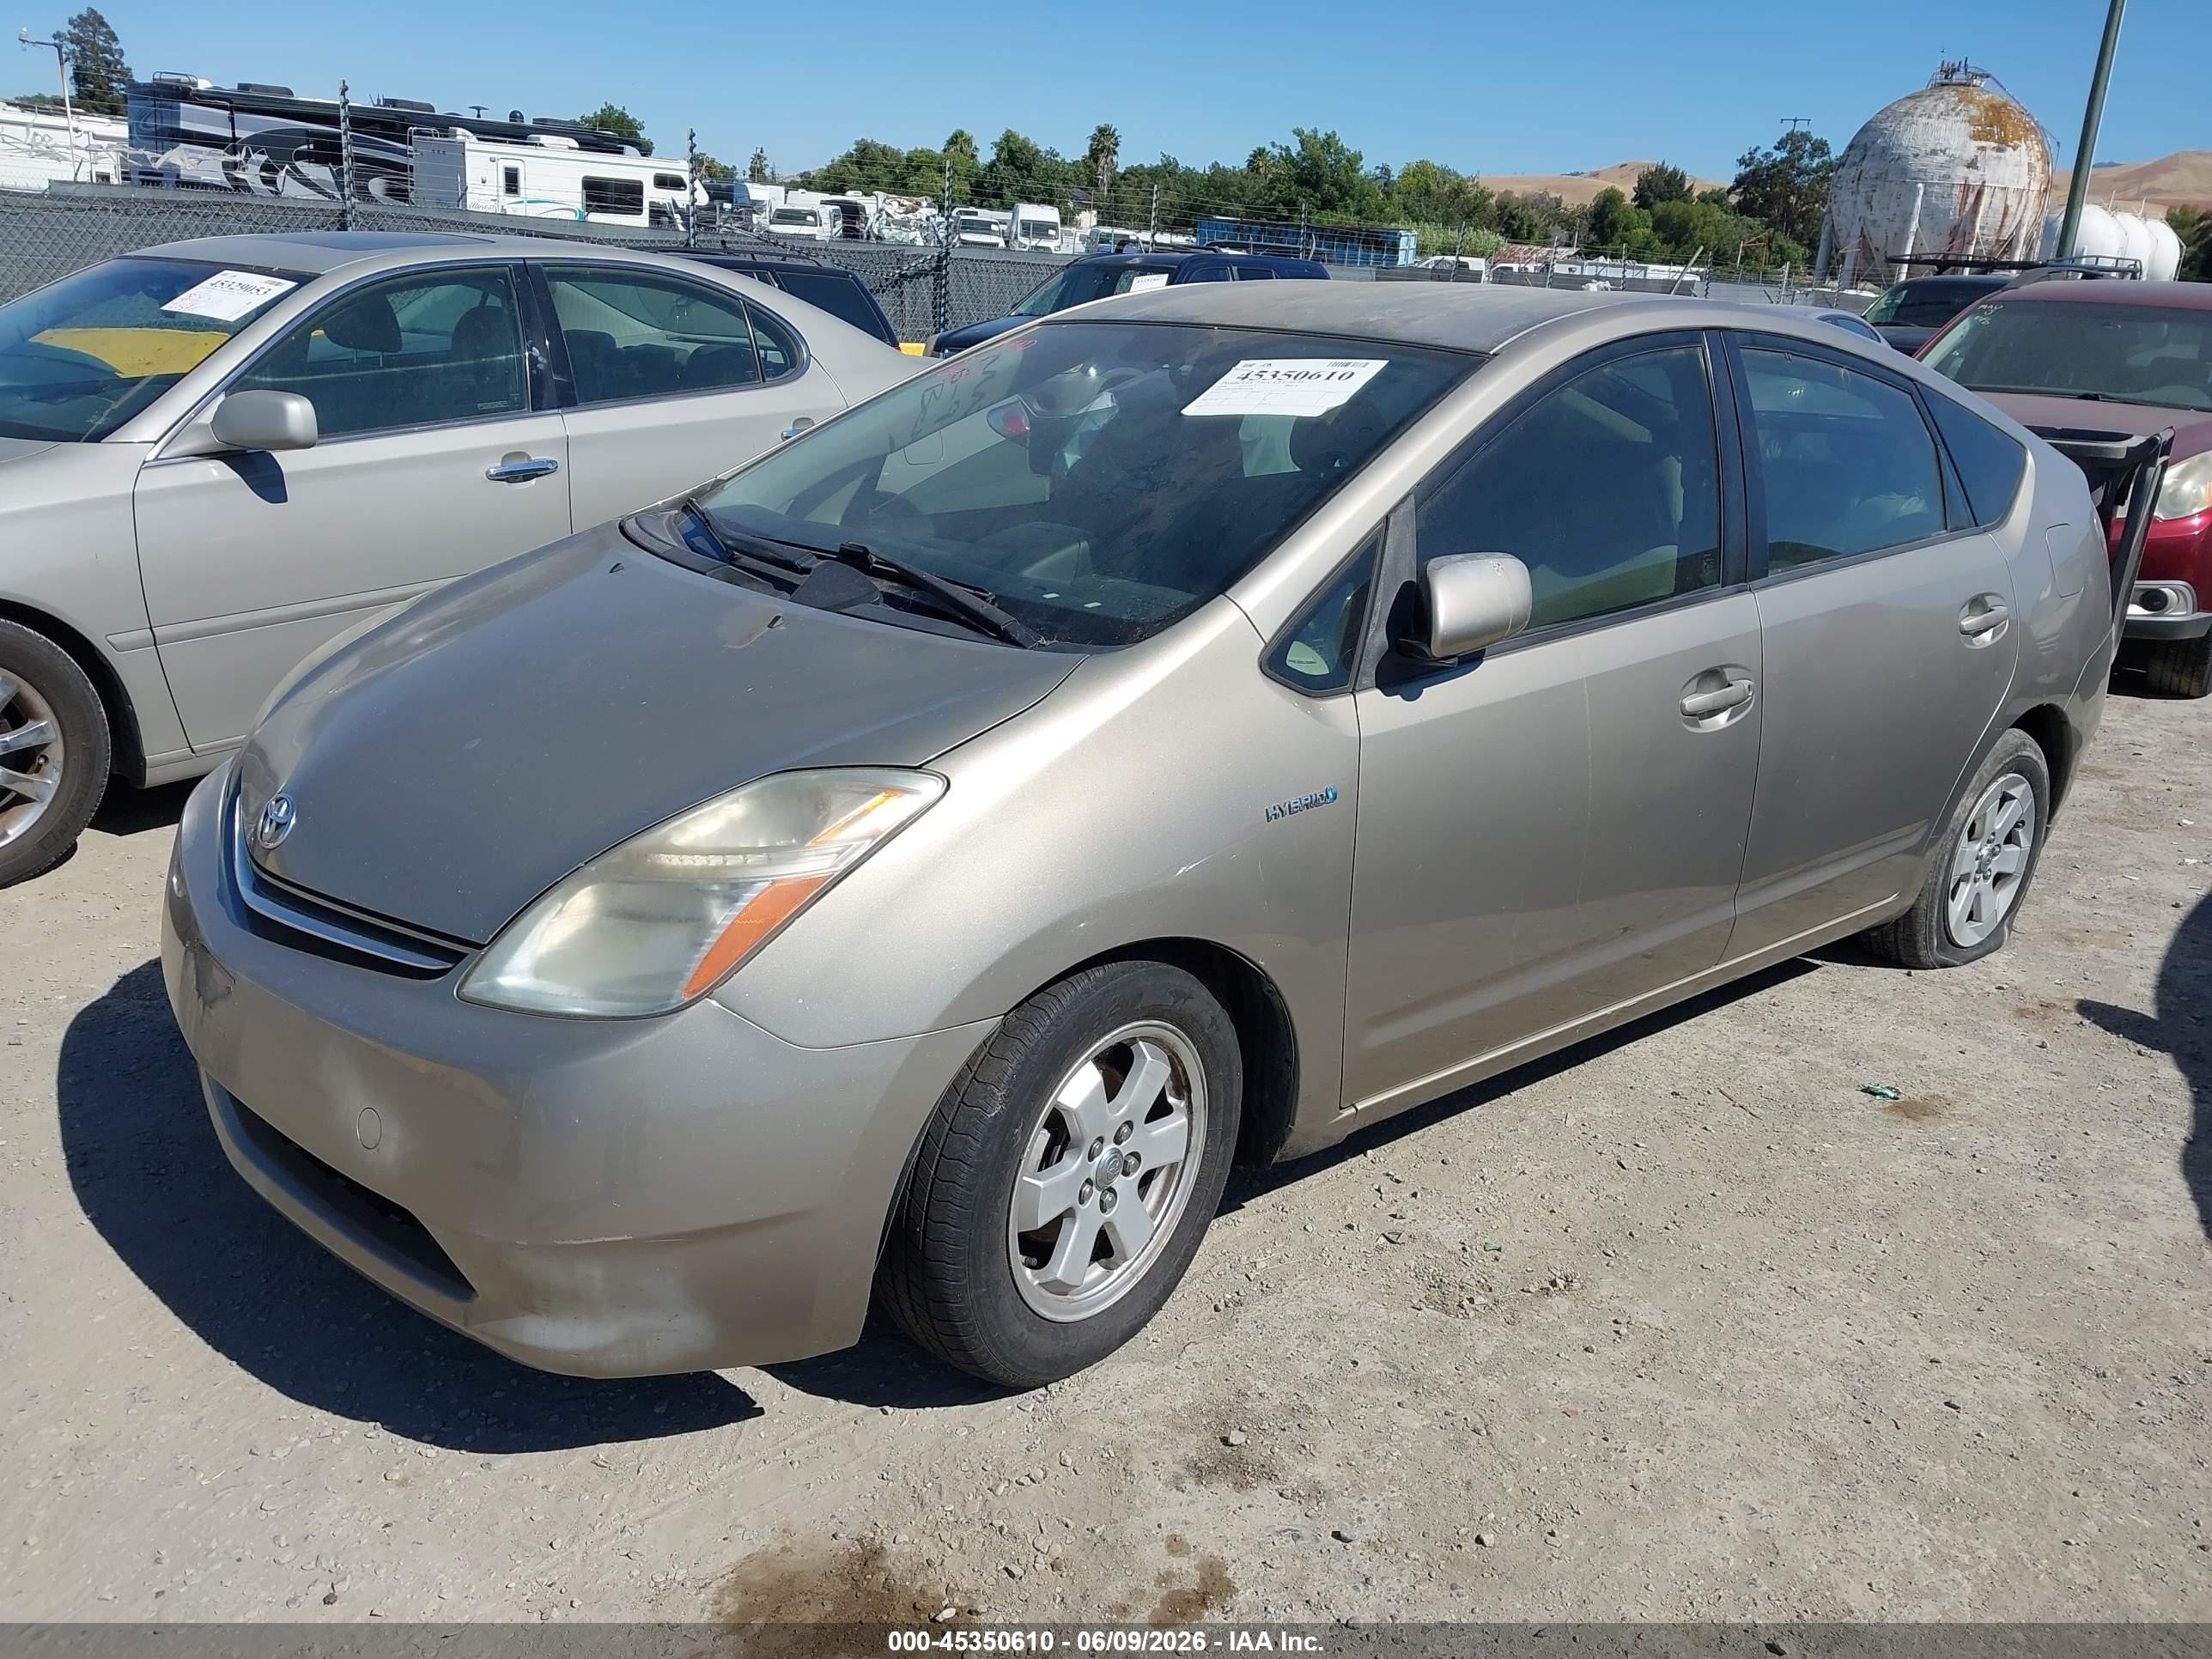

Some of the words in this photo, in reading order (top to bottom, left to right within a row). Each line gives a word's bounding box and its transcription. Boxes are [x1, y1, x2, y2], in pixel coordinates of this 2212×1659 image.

[210, 279, 271, 296] 45329053
[1236, 370, 1355, 381] 45350610
[1265, 792, 1328, 823] HYBRID
